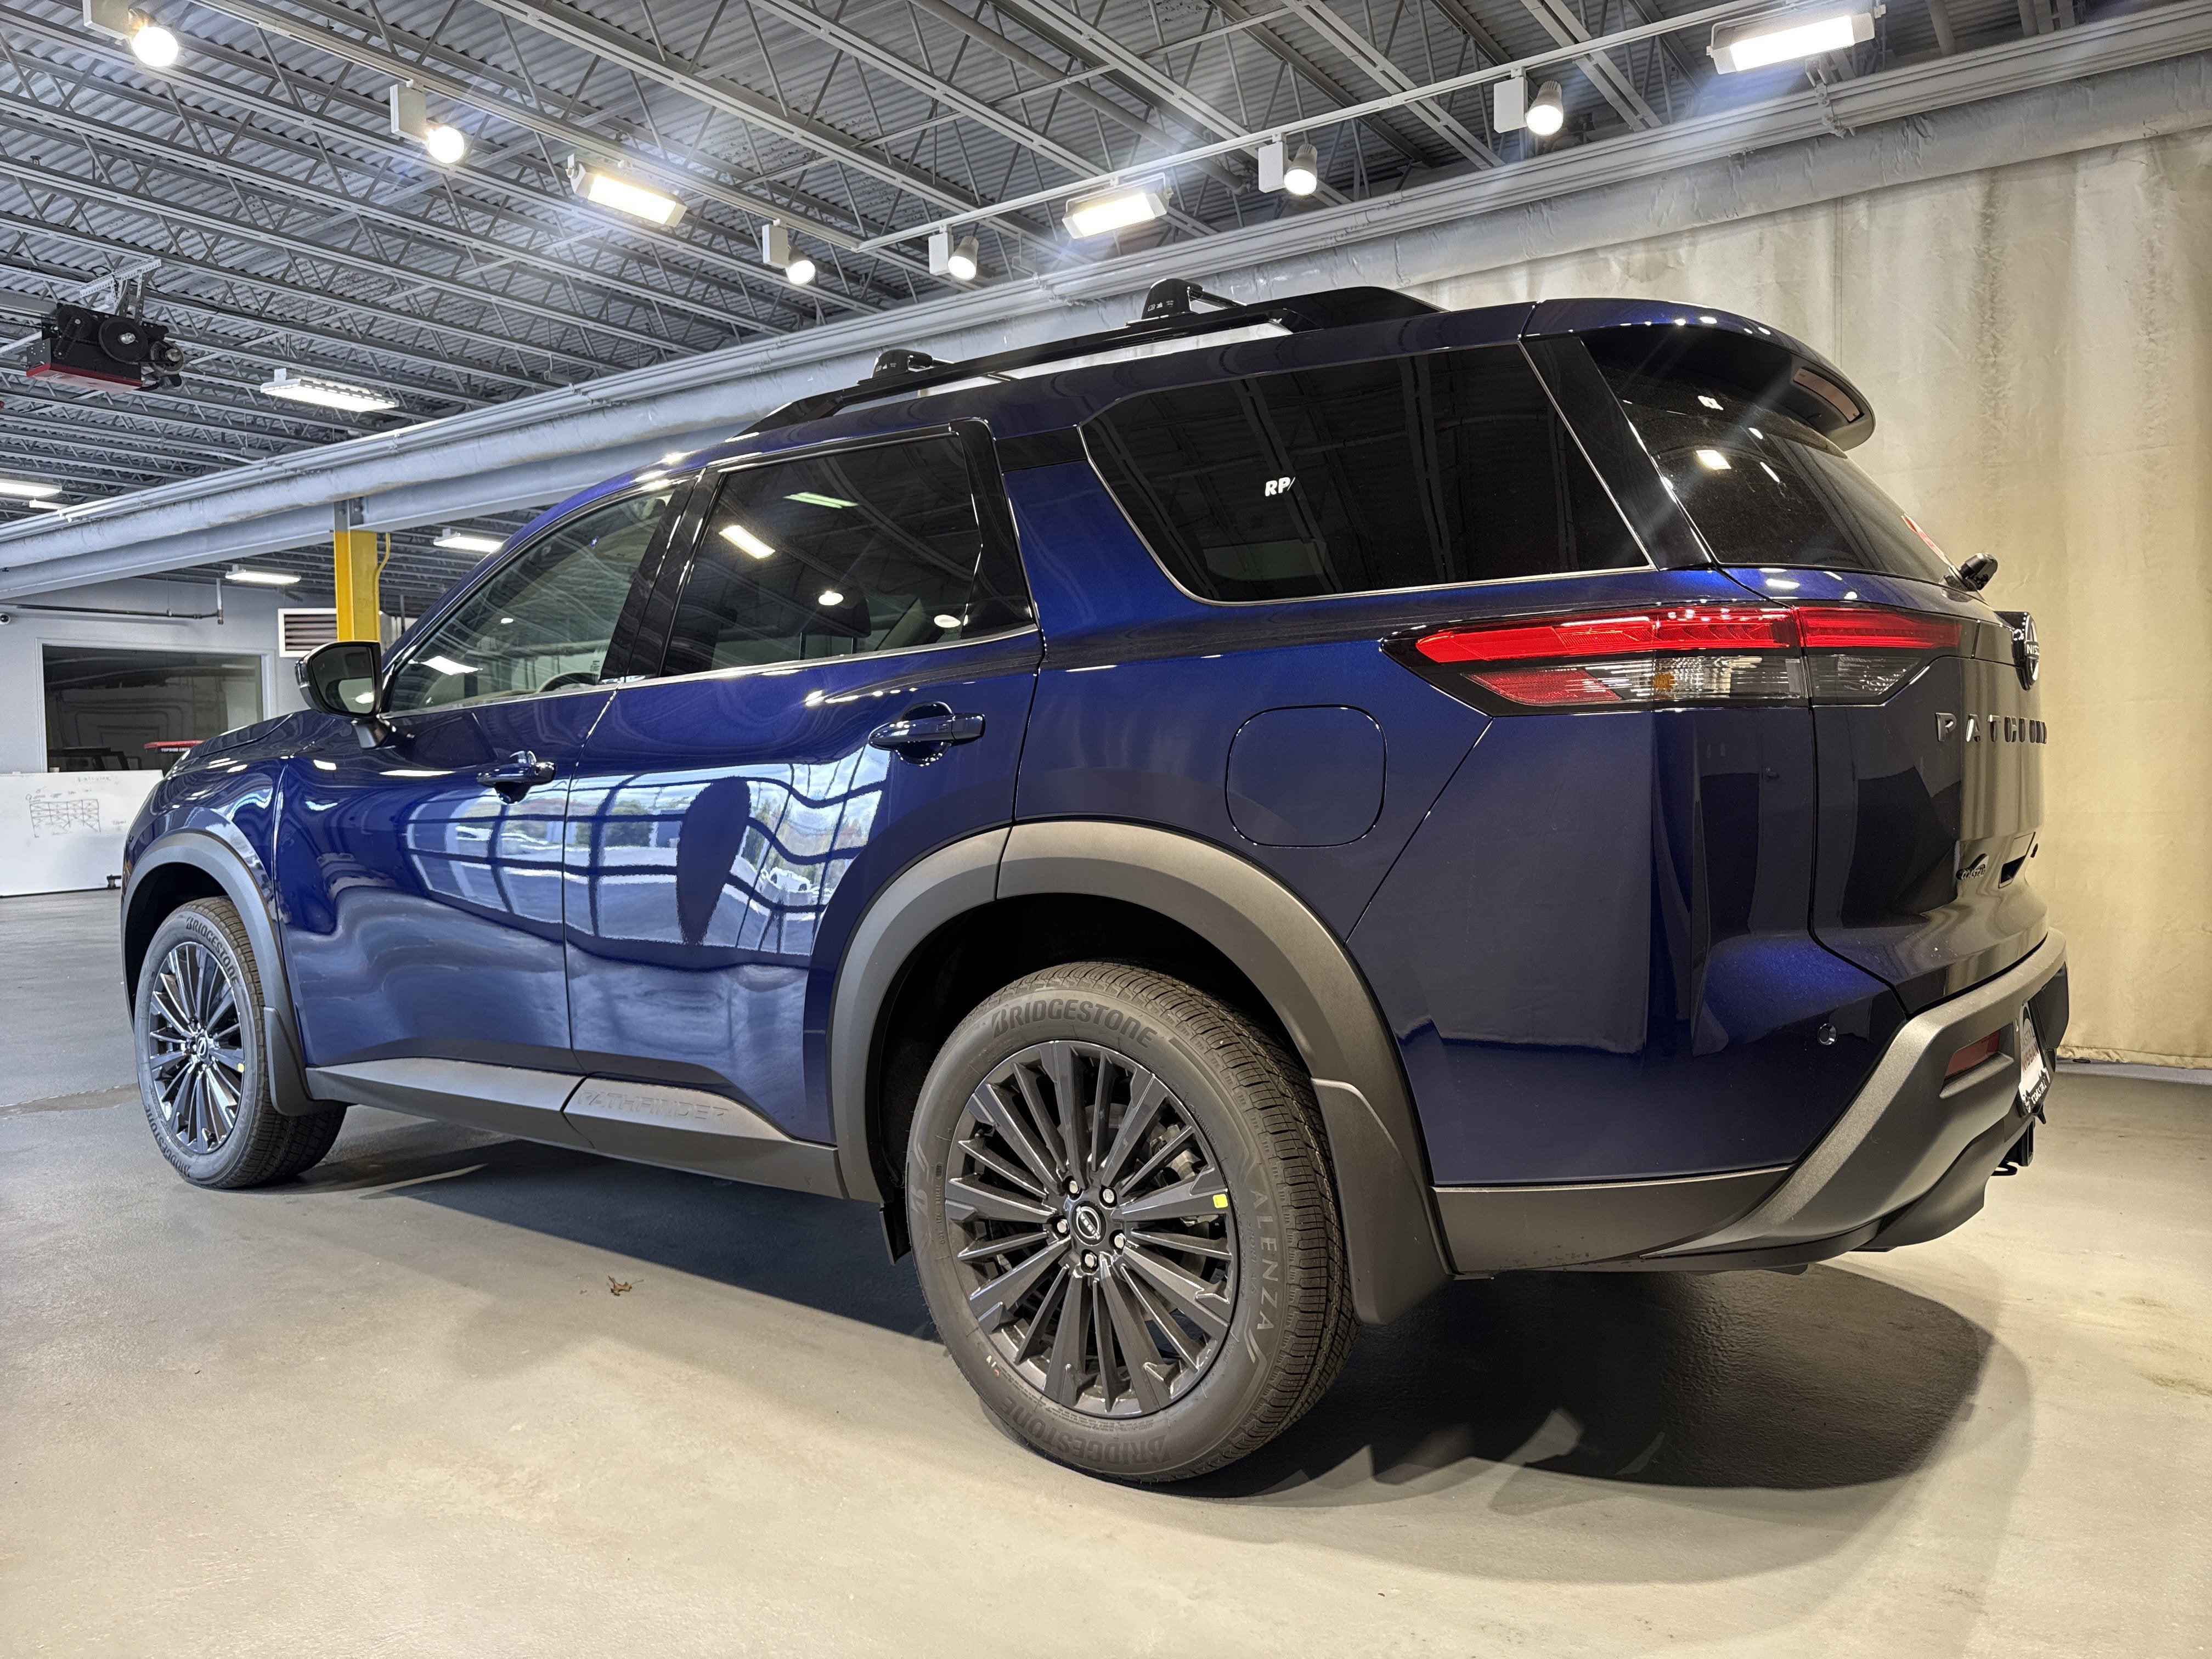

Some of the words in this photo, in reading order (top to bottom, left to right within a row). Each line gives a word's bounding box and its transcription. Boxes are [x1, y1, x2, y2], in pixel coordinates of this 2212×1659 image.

[185, 916, 240, 987] BRIDGESTONE
[991, 997, 1158, 1049] BRIDGESTONE
[577, 1089, 730, 1122] PATHFINDER
[1250, 1188, 1279, 1330] ALENZA
[998, 1396, 1172, 1465] BRIDGESTONE
